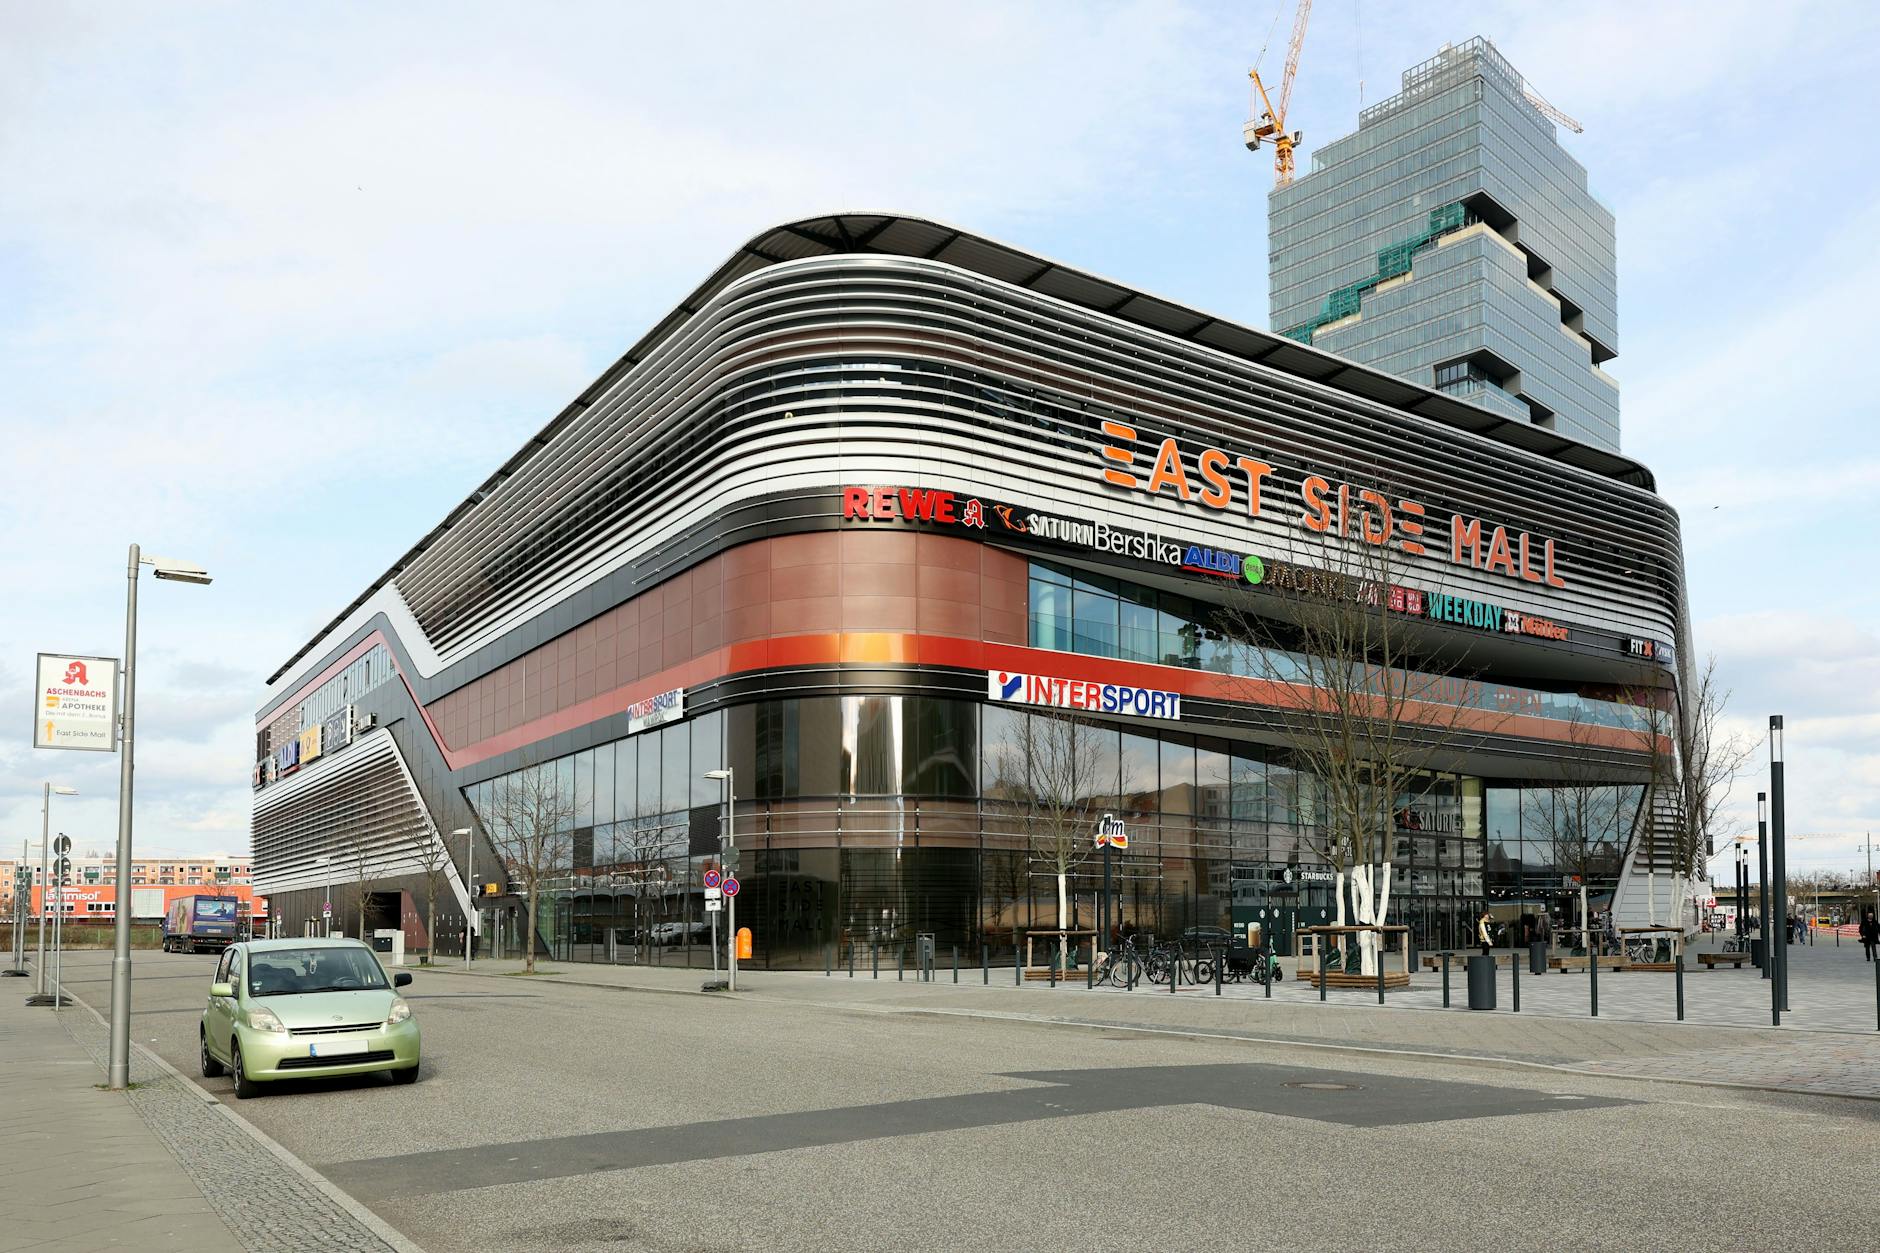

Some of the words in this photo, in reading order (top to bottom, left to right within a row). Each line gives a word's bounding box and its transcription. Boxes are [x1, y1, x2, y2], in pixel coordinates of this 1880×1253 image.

[843, 486, 956, 524] REWE
[1101, 421, 1272, 517] EAST
[1301, 475, 1426, 555] SIDE
[1451, 514, 1566, 588] MALL
[1028, 513, 1094, 547] SATURN
[1094, 520, 1182, 566] Bershka
[1183, 546, 1240, 575] ALDI
[1427, 592, 1501, 632] WEEKDAY
[46, 688, 107, 698] ASCHENBACHS
[61, 703, 107, 712] APOTHEKE
[1027, 675, 1180, 717] INTERSPORT
[1300, 872, 1334, 881] STARBUCKS
